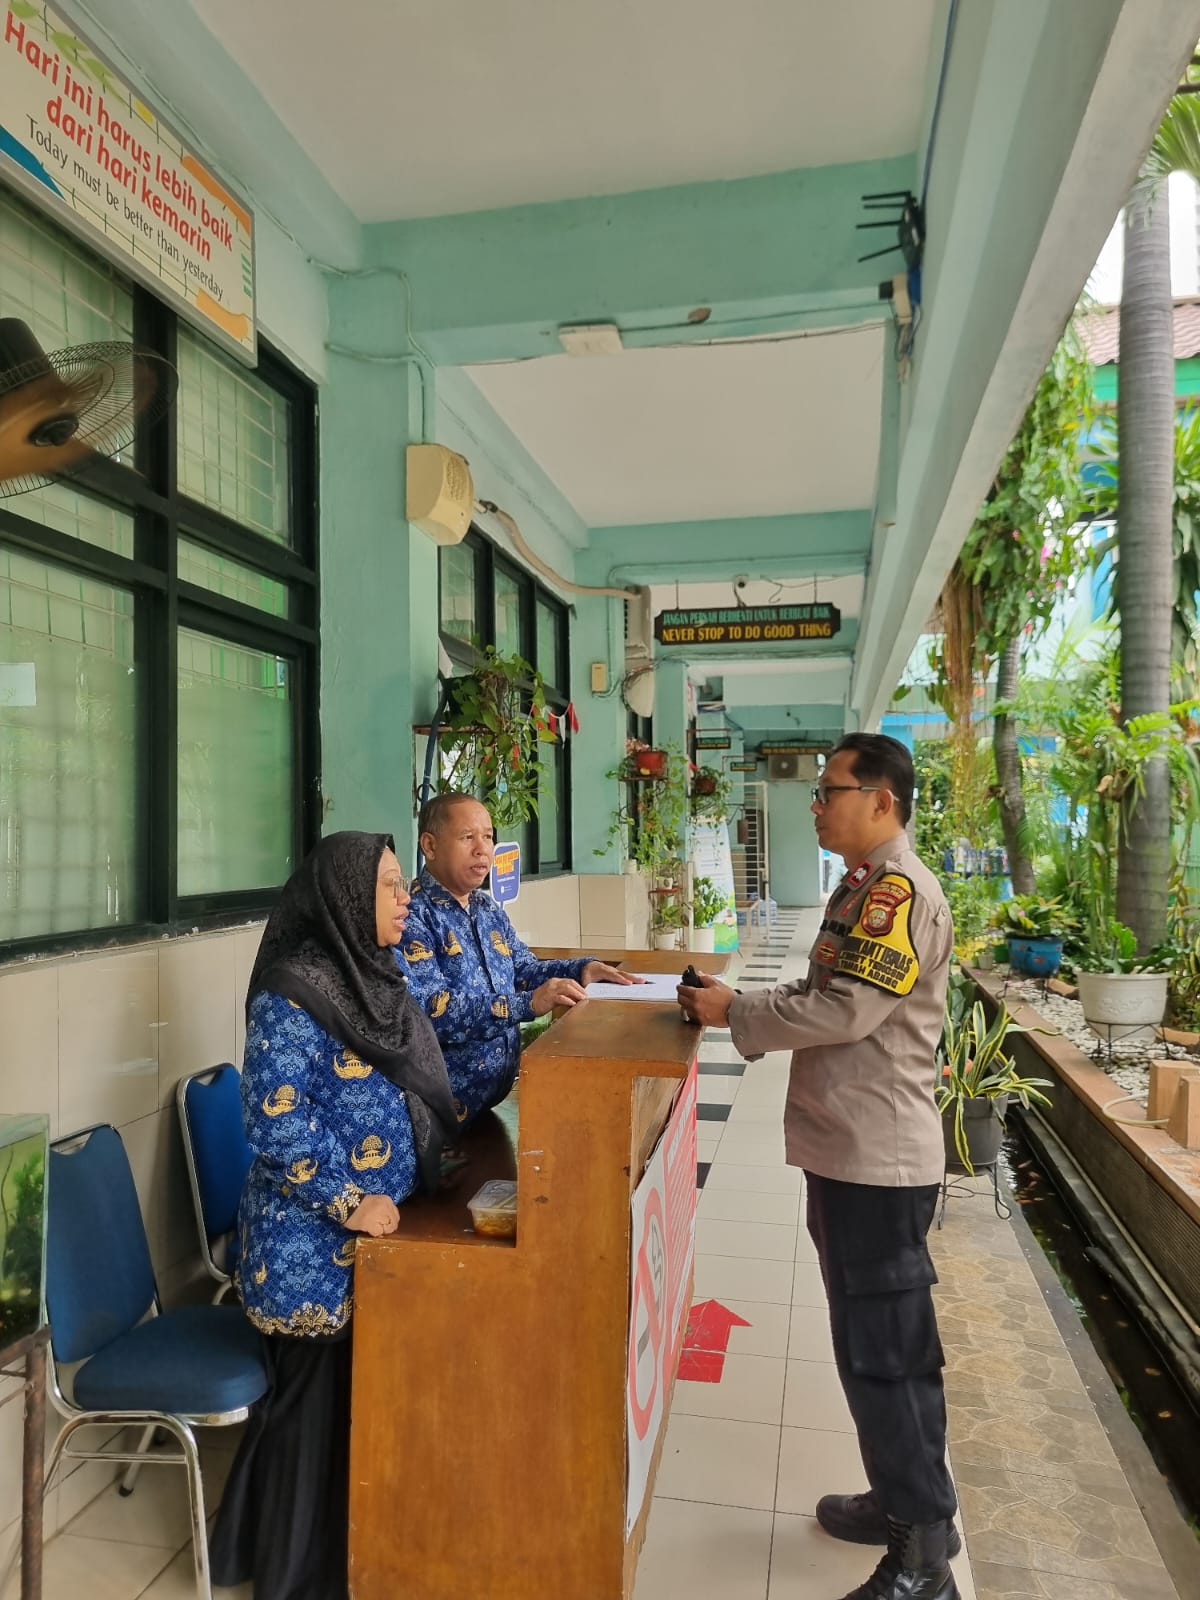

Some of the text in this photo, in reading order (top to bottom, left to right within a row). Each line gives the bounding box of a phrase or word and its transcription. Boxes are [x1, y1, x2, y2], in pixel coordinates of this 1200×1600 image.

[5, 10, 233, 251] Hari ini harus lebih baik
[26, 113, 224, 301] Today must be better than yesterday
[46, 96, 211, 261] dari hari kemarin
[662, 622, 831, 641] NEVER STOP TO DO GOOD THING
